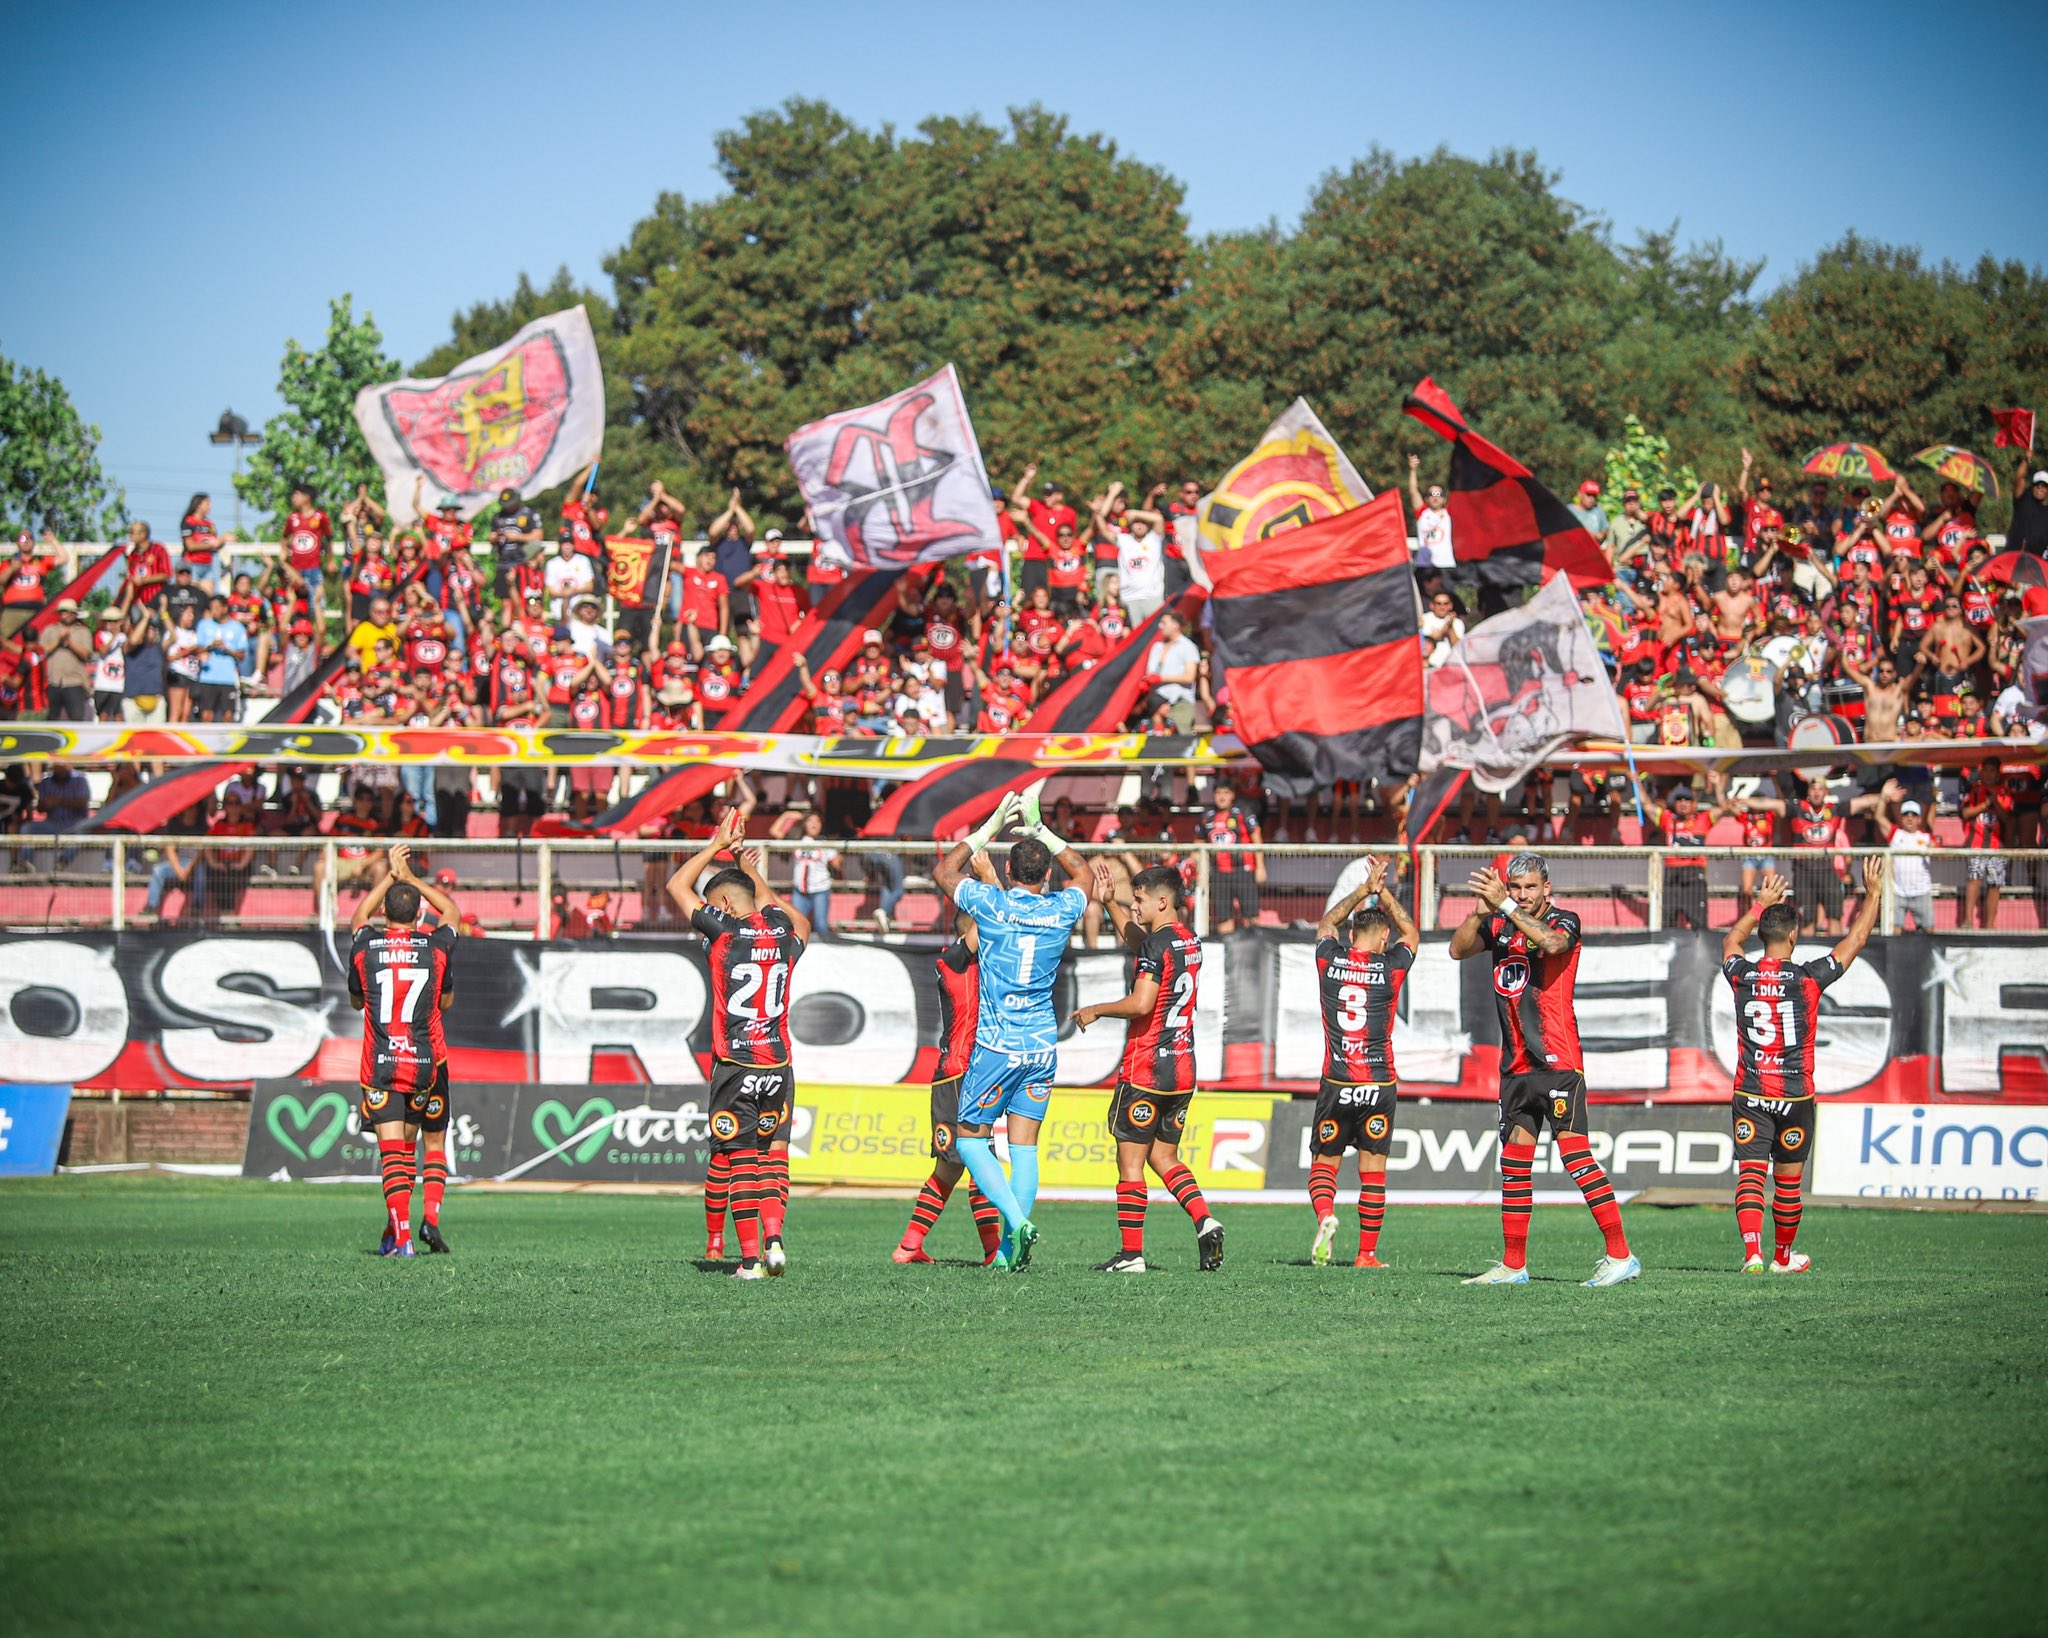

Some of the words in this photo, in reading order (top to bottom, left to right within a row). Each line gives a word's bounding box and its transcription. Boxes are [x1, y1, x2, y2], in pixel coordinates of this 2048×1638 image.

[751, 947, 781, 961] MOYA
[1017, 935, 1037, 985] 1
[1327, 965, 1386, 985] SANHUEZA
[1754, 970, 1794, 978] MALPO
[375, 968, 429, 1024] 17
[727, 962, 789, 1020] 20
[1760, 982, 1786, 997] DÍAZ
[1337, 985, 1368, 1032] 3
[1744, 1000, 1797, 1047] 31
[823, 1109, 882, 1133] rent
[897, 1114, 917, 1132] a
[606, 1149, 686, 1165] Corazón
